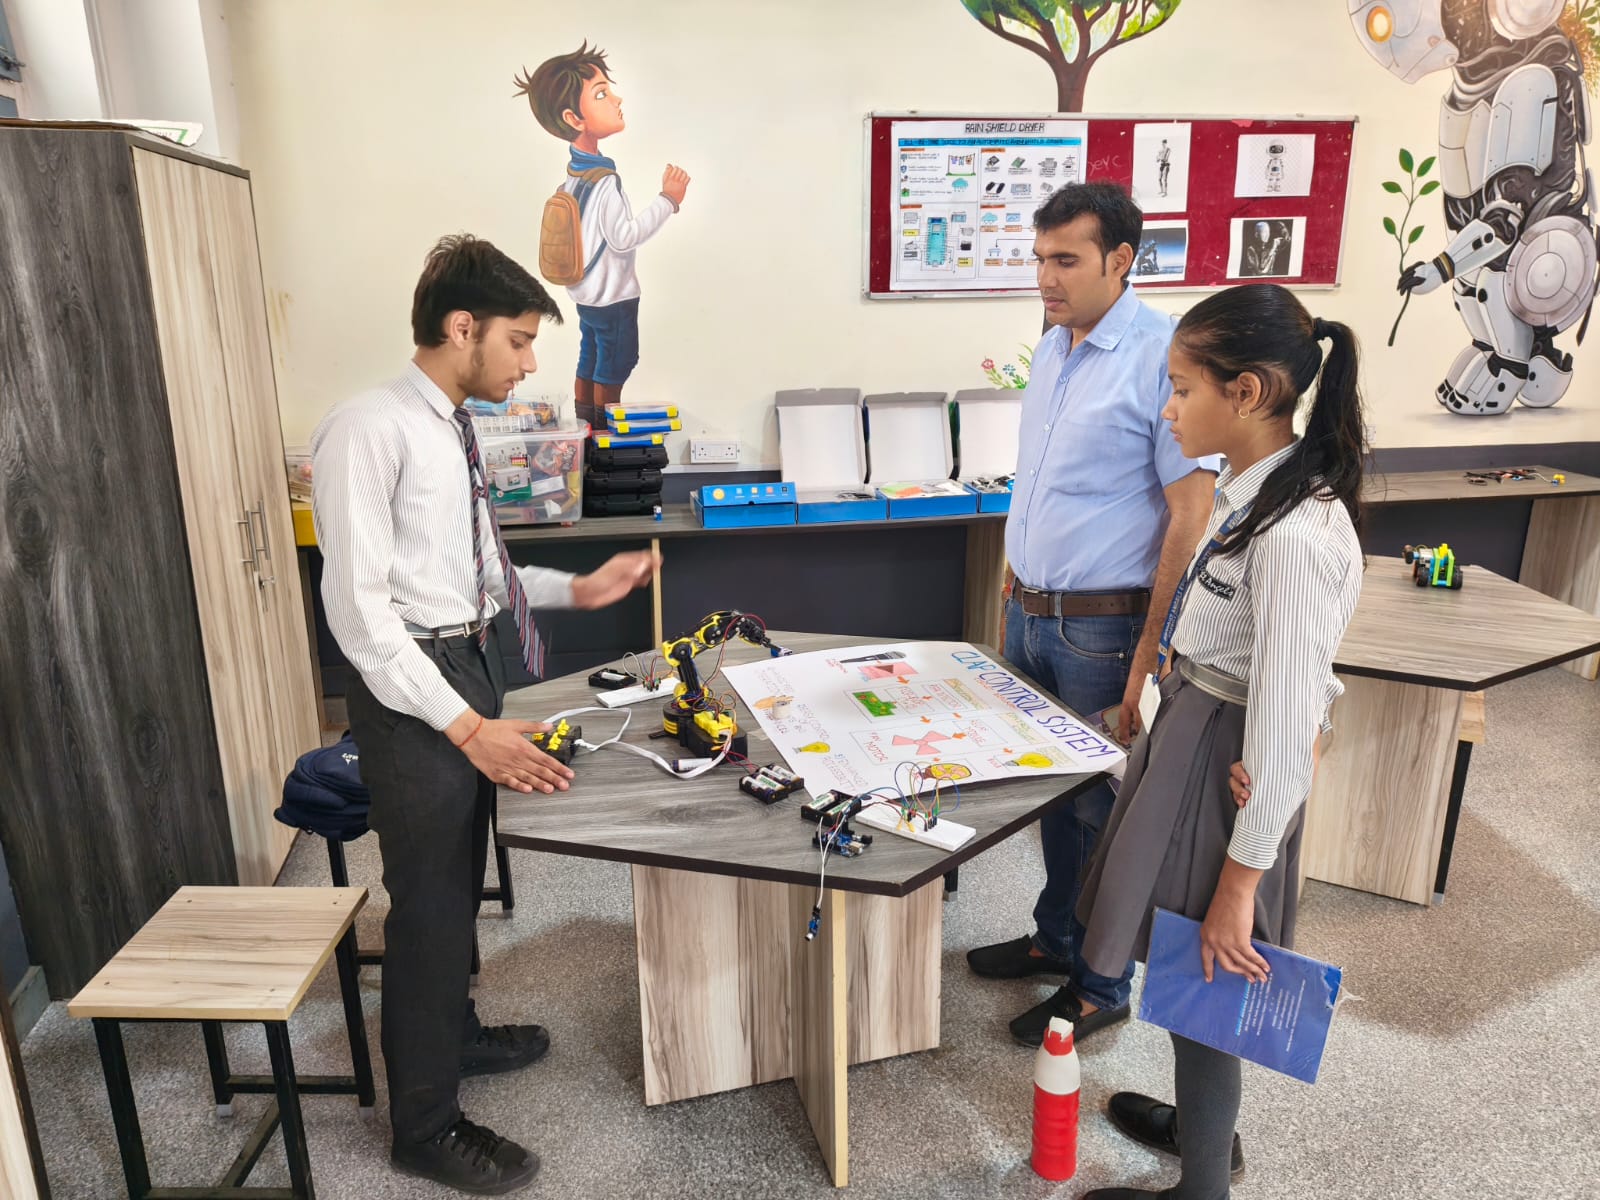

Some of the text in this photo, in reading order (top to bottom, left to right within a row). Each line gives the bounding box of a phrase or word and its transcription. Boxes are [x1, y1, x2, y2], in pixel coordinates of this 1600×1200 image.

[965, 122, 984, 133] RAIN
[985, 122, 1017, 133] SHIELD
[951, 650, 996, 671] CLAP
[979, 671, 1051, 718] CONTROL
[1037, 715, 1118, 760] SYSTEM
[864, 741, 889, 763] MOTOR
